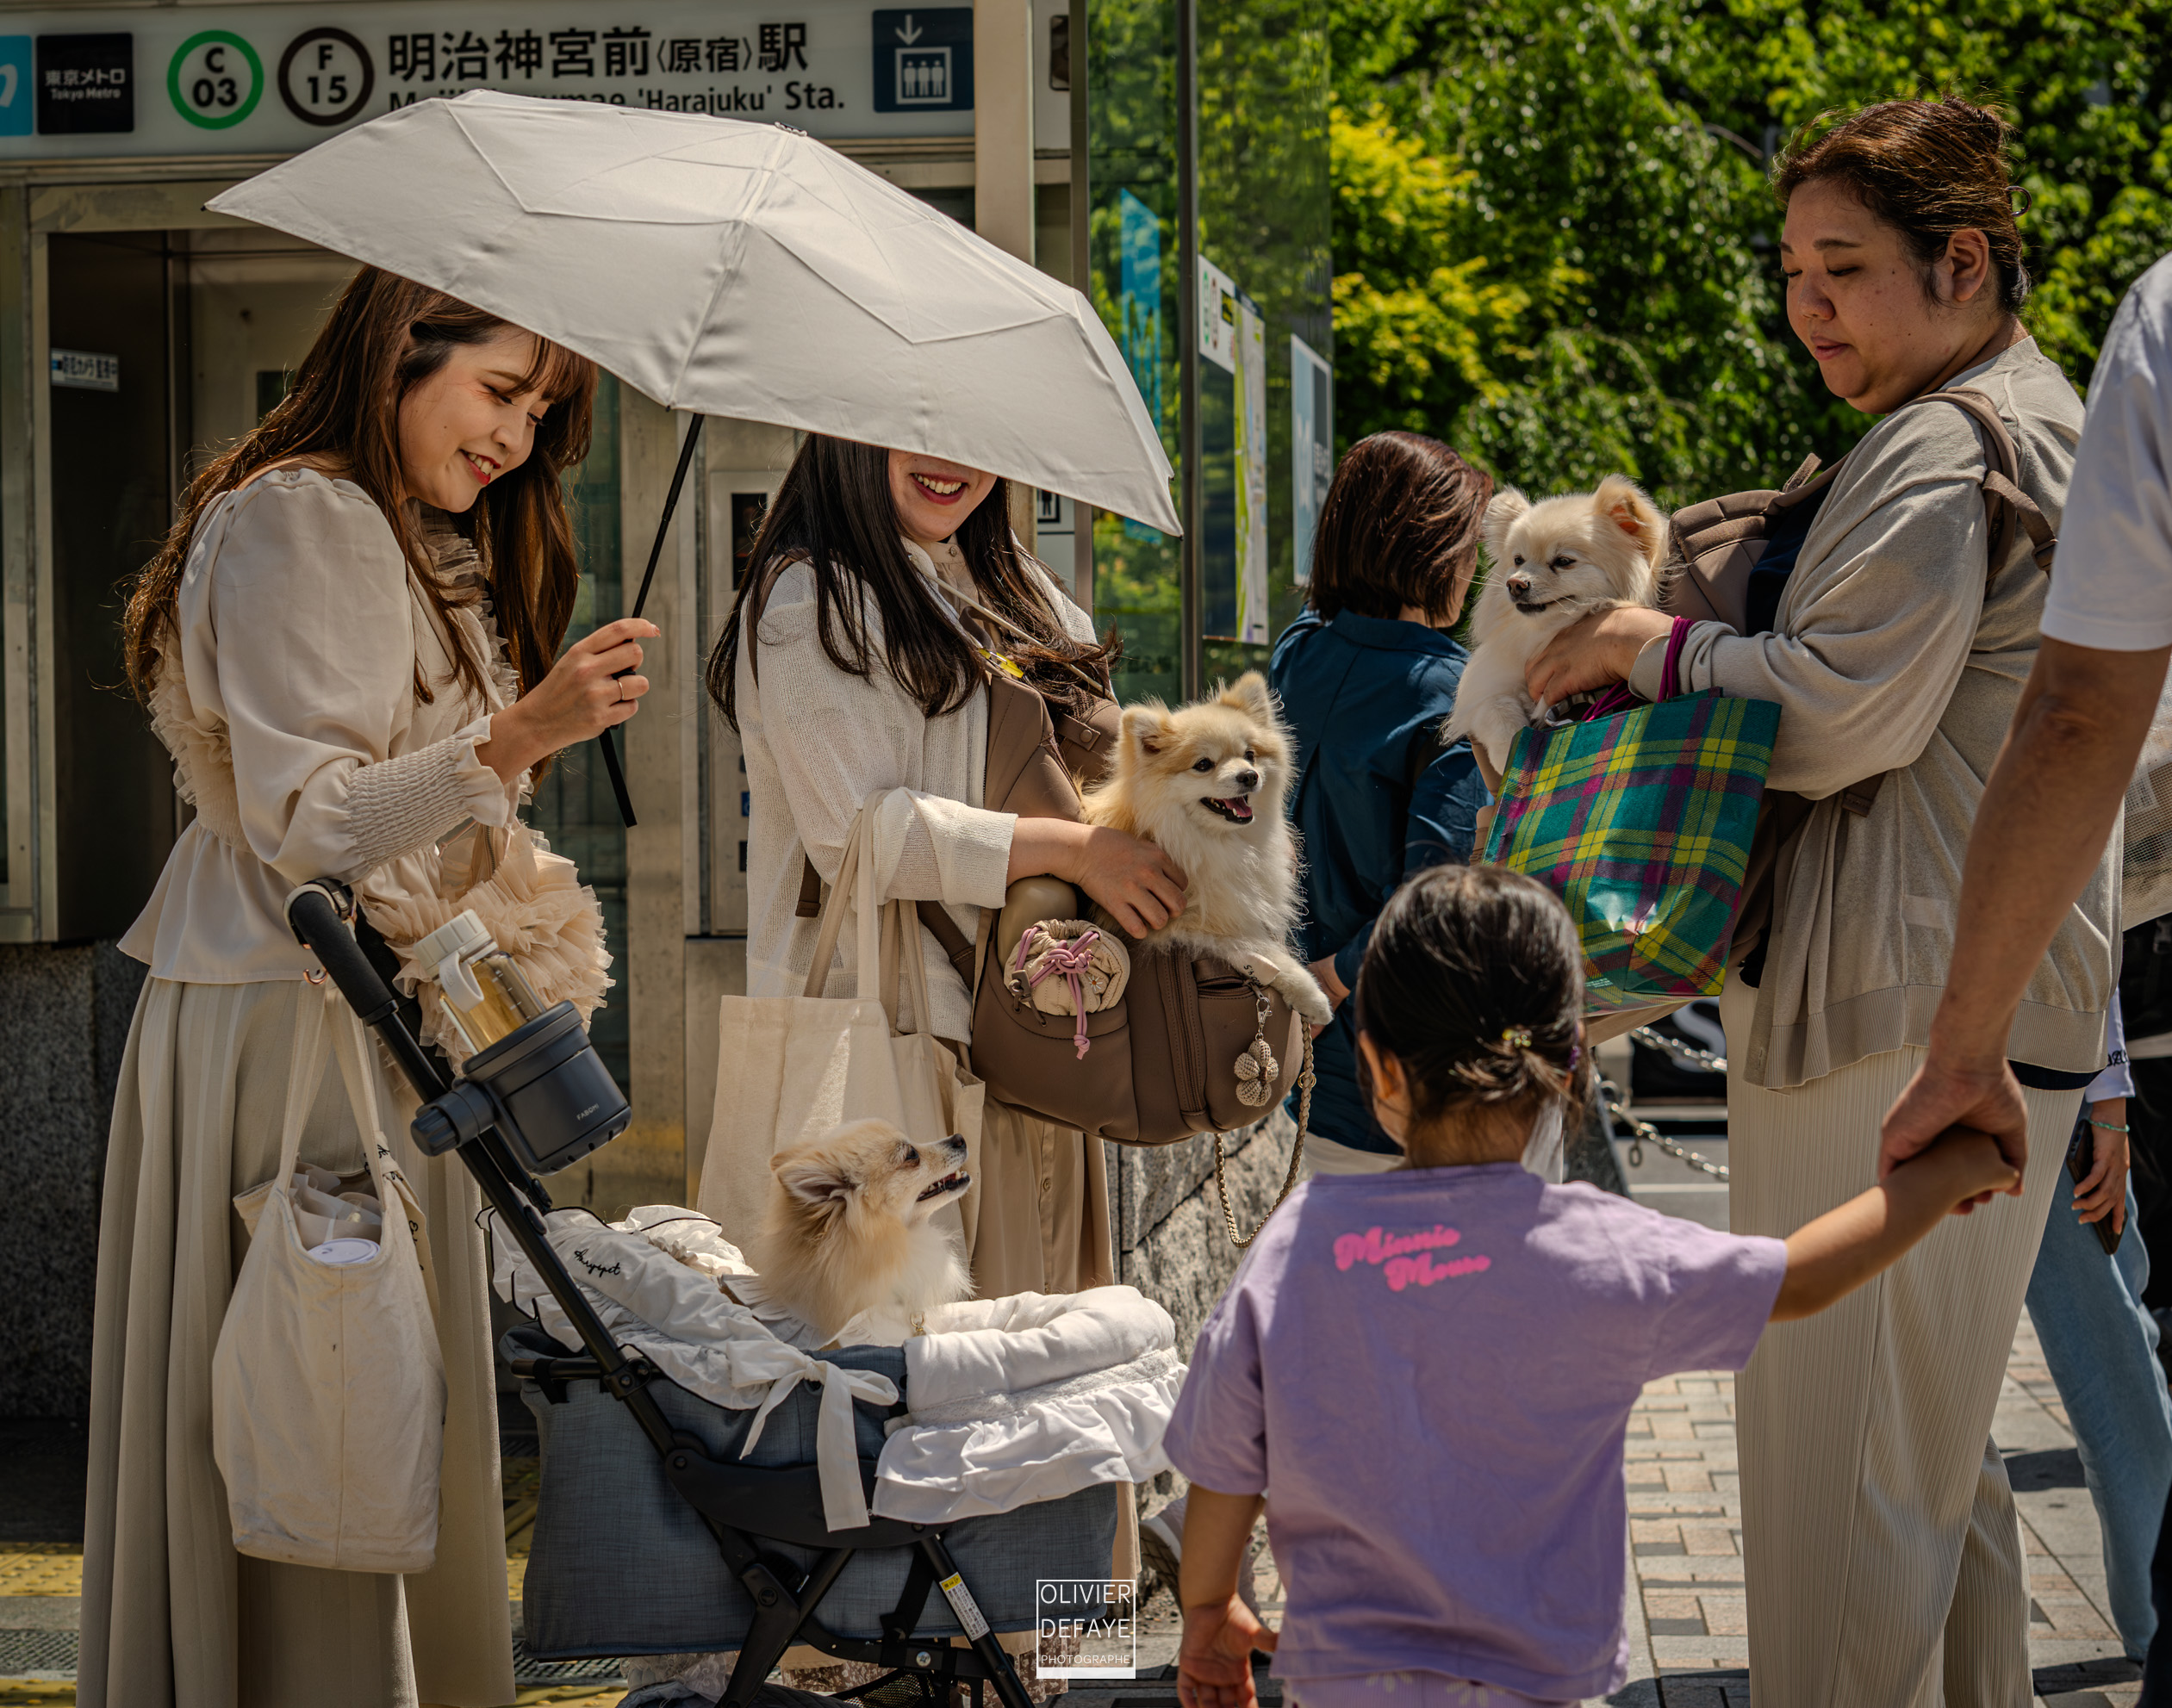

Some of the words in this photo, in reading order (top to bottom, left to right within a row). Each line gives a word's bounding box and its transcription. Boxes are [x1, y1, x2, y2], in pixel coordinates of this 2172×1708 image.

[204, 47, 225, 74] C
[318, 44, 333, 71] F
[389, 22, 808, 83] 明治神宮前〈原宿〉駅
[44, 68, 126, 85] 東京メトロ
[307, 75, 348, 104] 15
[50, 88, 84, 102] Tokyo
[87, 87, 121, 99] Metro
[192, 78, 238, 108] 03
[785, 81, 844, 109] Sta.
